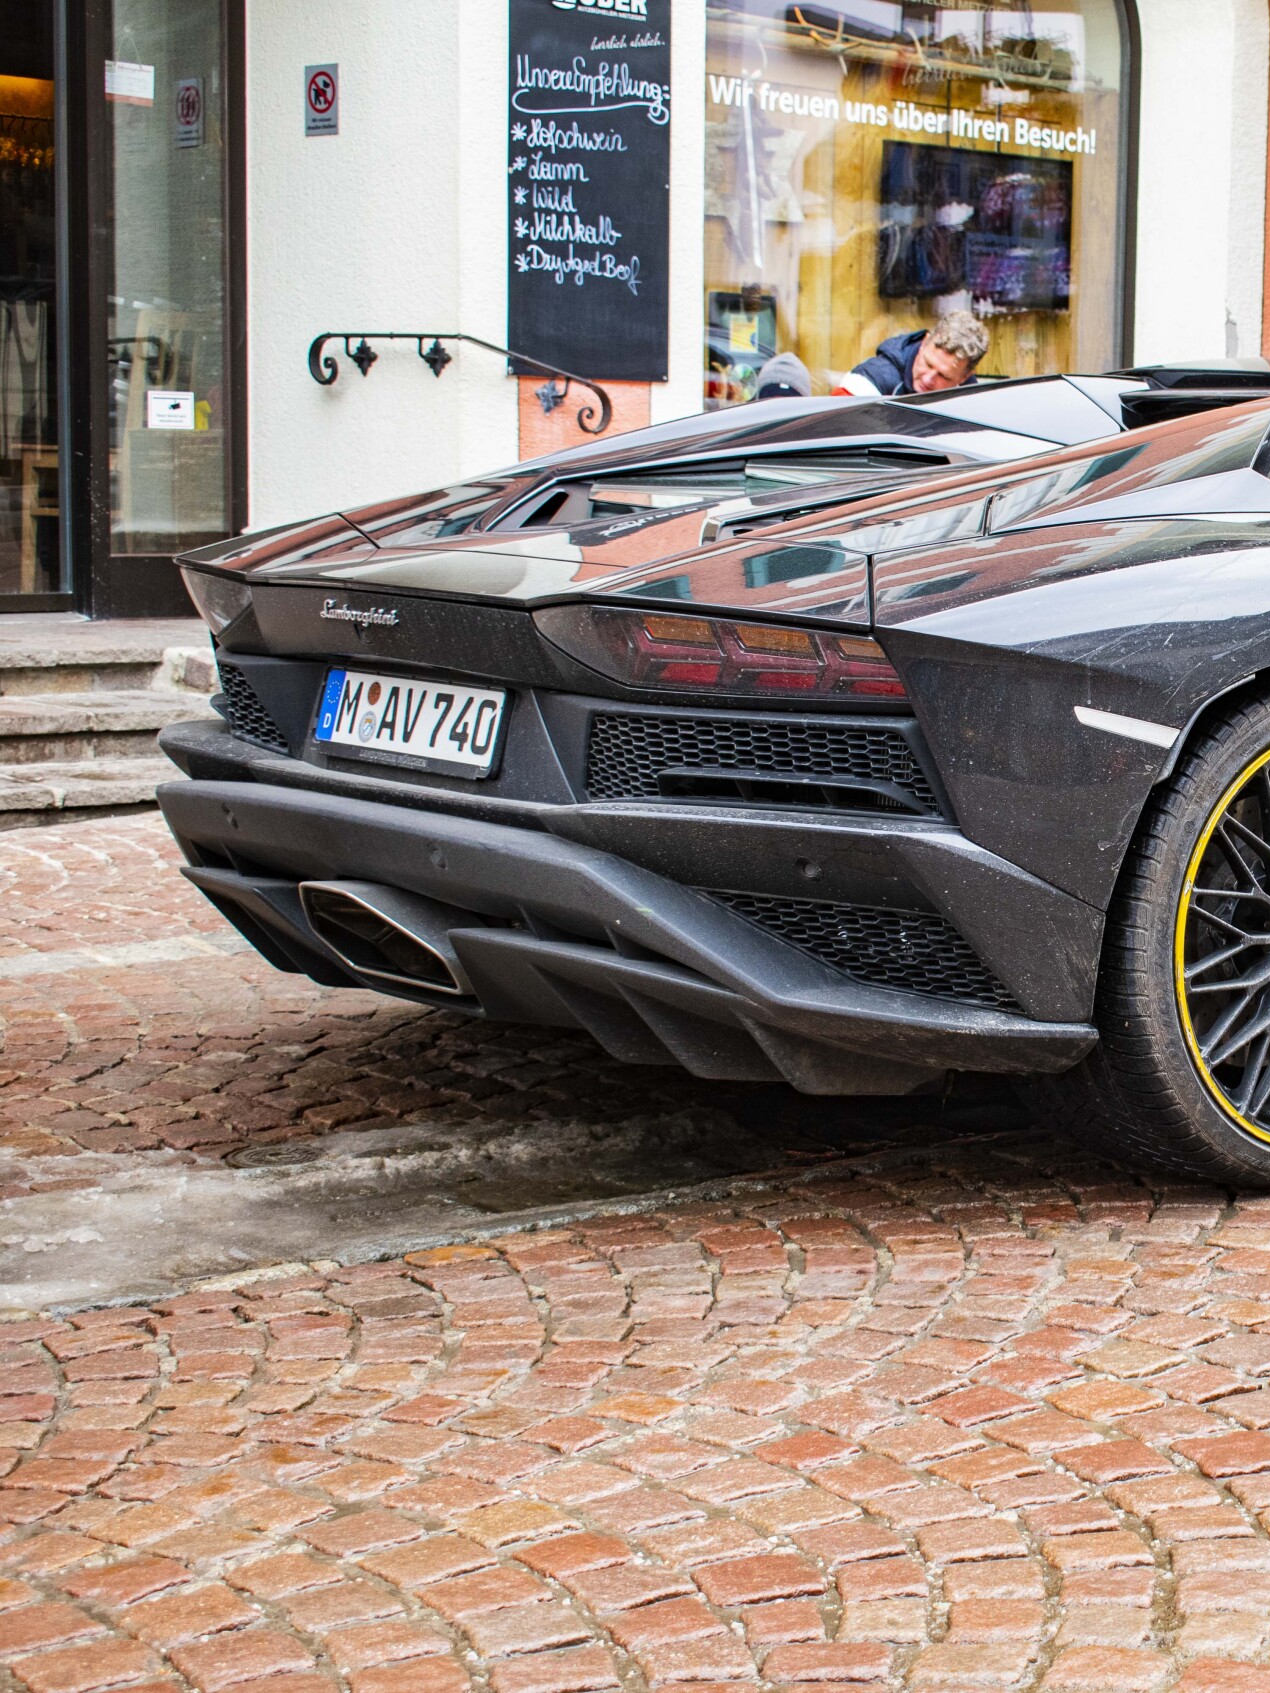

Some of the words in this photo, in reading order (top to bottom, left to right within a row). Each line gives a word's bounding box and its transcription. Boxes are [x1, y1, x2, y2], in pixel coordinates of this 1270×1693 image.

[709, 76, 754, 107] Wir
[758, 83, 840, 120] freuen
[845, 101, 888, 127] uns
[894, 101, 950, 135] über
[952, 108, 1010, 142] Ihren
[1014, 118, 1097, 155] Besuch!
[526, 118, 628, 154] Hofschwein
[528, 151, 590, 182] Lamm
[532, 183, 578, 213] Wild
[530, 211, 623, 246] Milchkalb
[602, 253, 643, 296] Beef
[320, 599, 399, 627] Lamborghini
[322, 713, 331, 728] D
[335, 679, 364, 735] M
[376, 686, 428, 743] AV
[429, 692, 498, 756] 740
